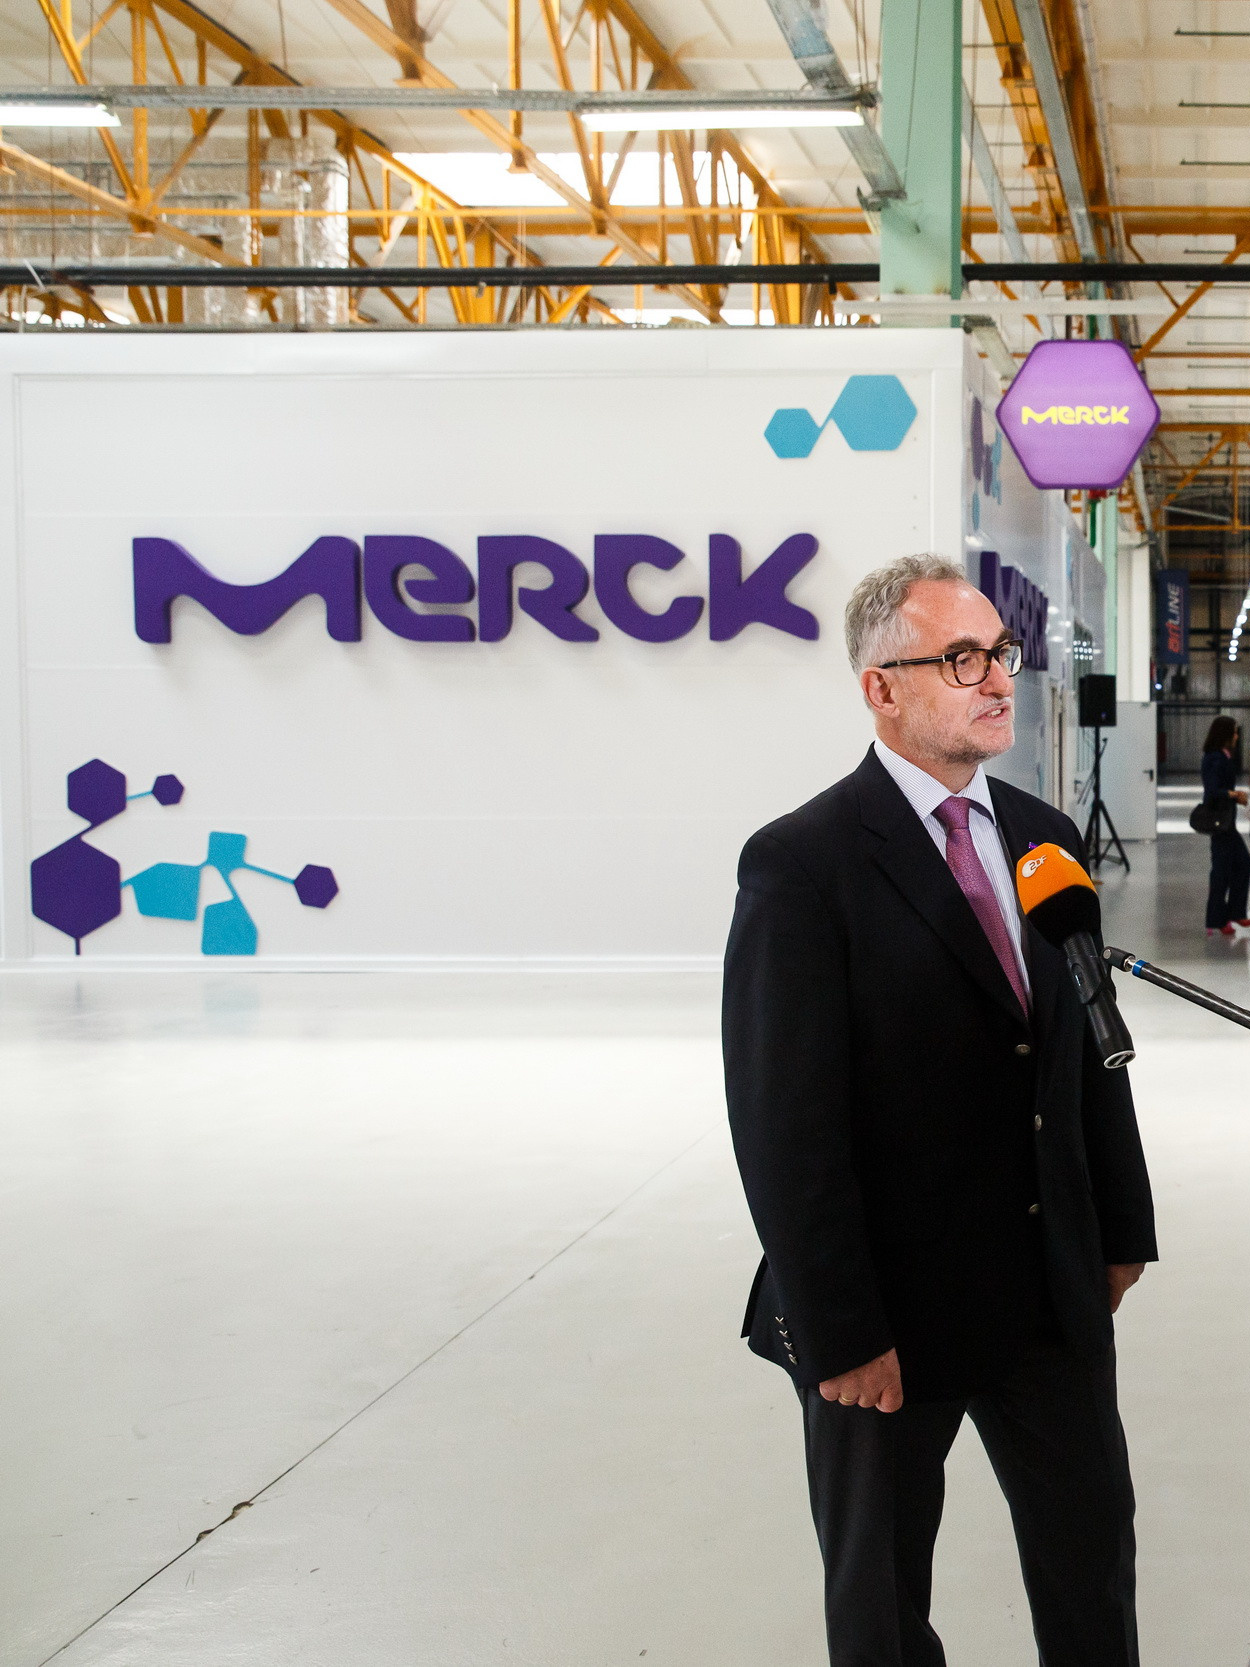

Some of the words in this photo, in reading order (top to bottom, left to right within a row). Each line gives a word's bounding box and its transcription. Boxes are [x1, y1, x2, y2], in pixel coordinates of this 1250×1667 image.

[1021, 405, 1130, 425] MERCK
[132, 533, 820, 644] MERCK
[1027, 854, 1047, 872] ZDF
